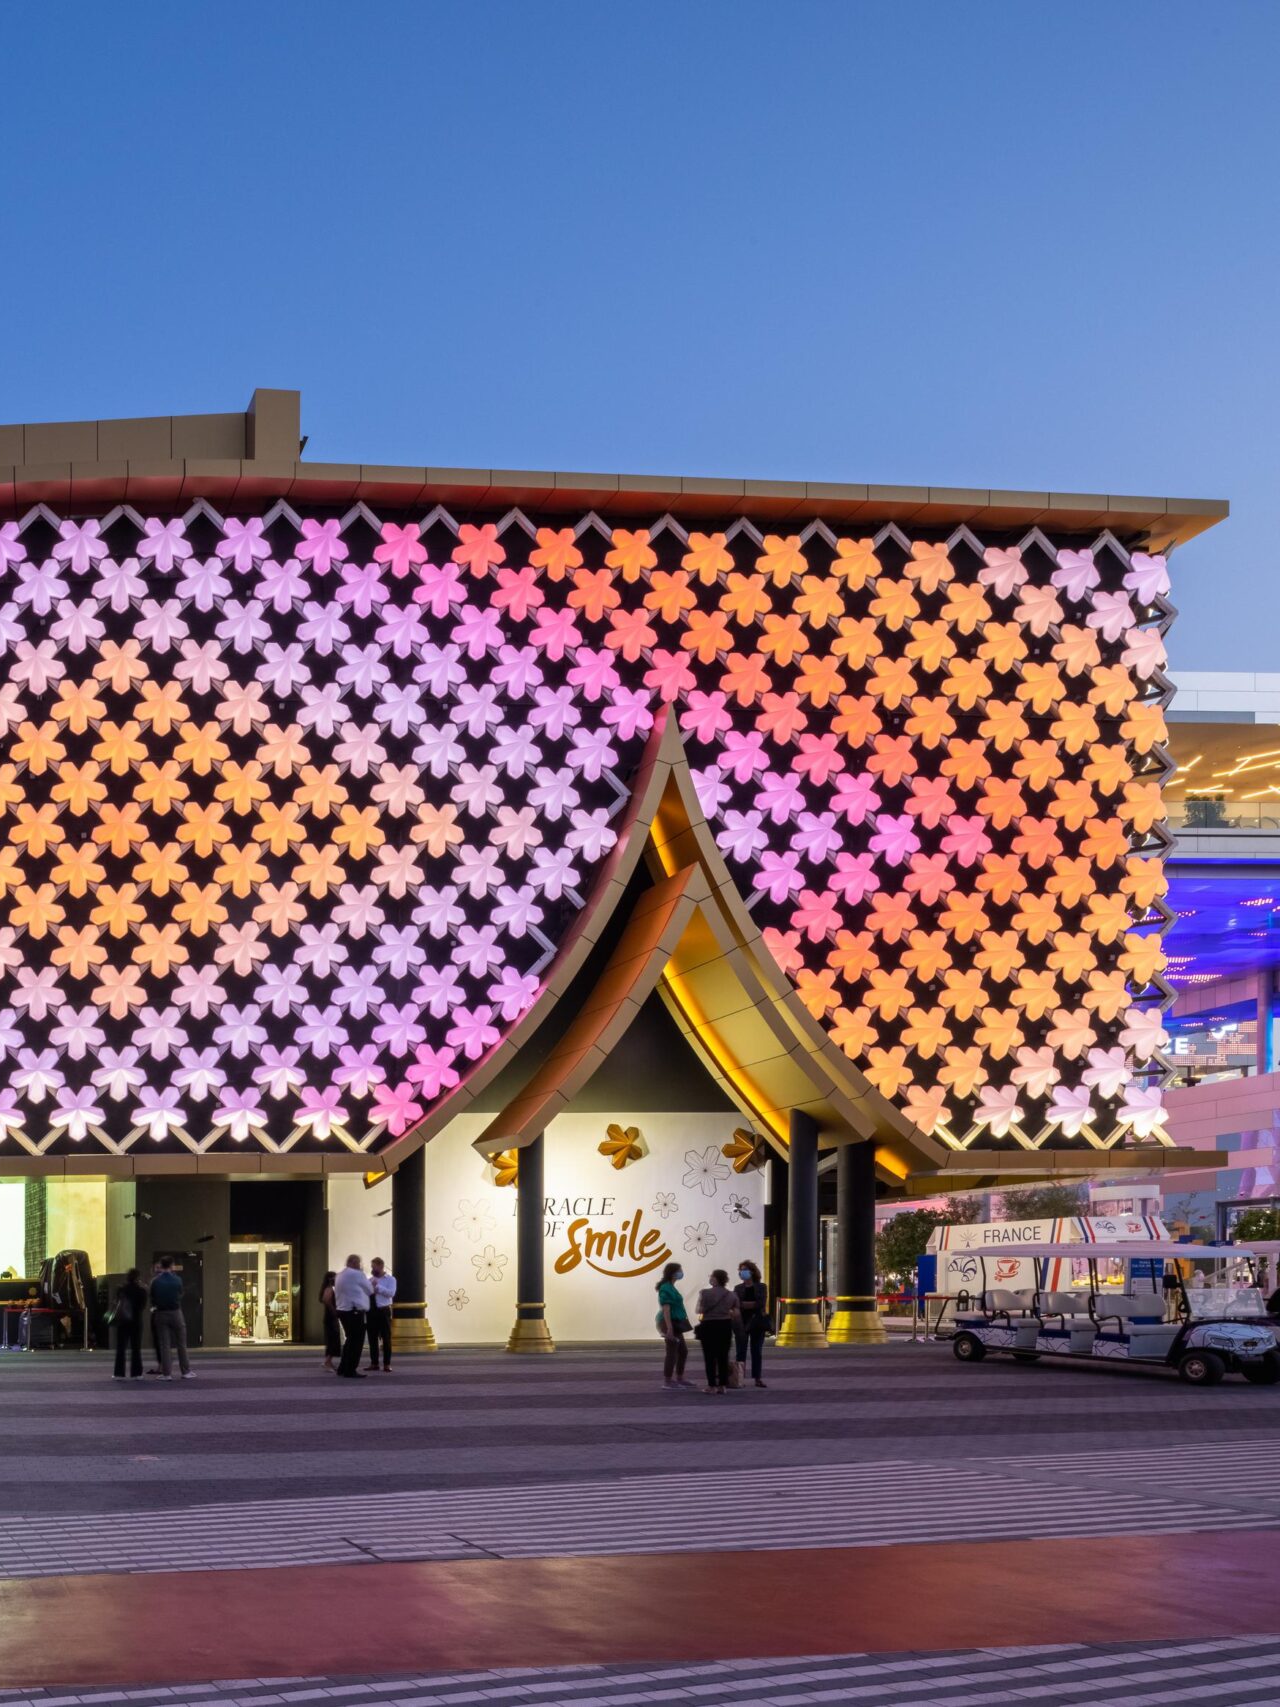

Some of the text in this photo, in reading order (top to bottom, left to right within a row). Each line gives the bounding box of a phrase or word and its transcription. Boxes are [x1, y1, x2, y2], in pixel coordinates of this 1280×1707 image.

[513, 1197, 616, 1216] RACLE
[554, 1208, 668, 1275] Smile
[983, 1226, 1041, 1243] FRANCE
